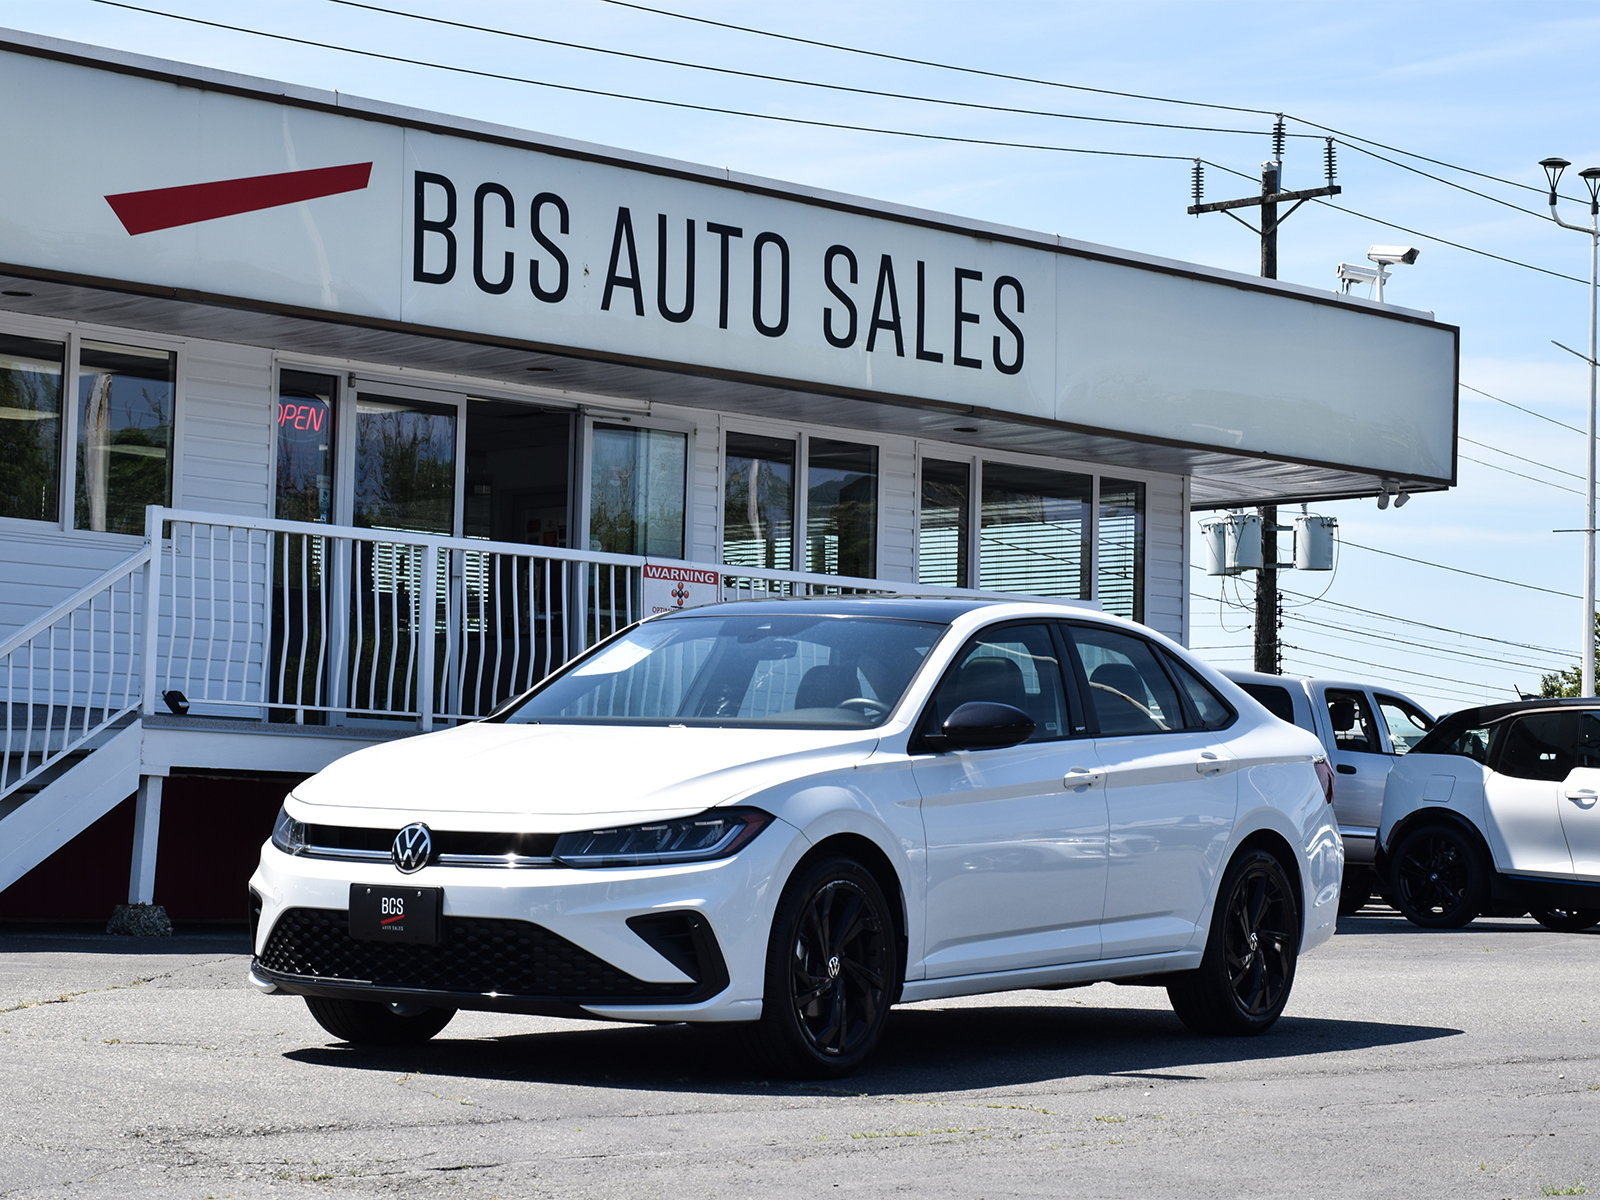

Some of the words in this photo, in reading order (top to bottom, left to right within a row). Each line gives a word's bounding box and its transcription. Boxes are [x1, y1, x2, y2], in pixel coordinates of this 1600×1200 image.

[413, 170, 570, 304] BCS
[600, 206, 790, 338] AUTO
[823, 244, 1025, 376] SALES
[646, 567, 714, 583] WARNING
[381, 897, 404, 914] BCS
